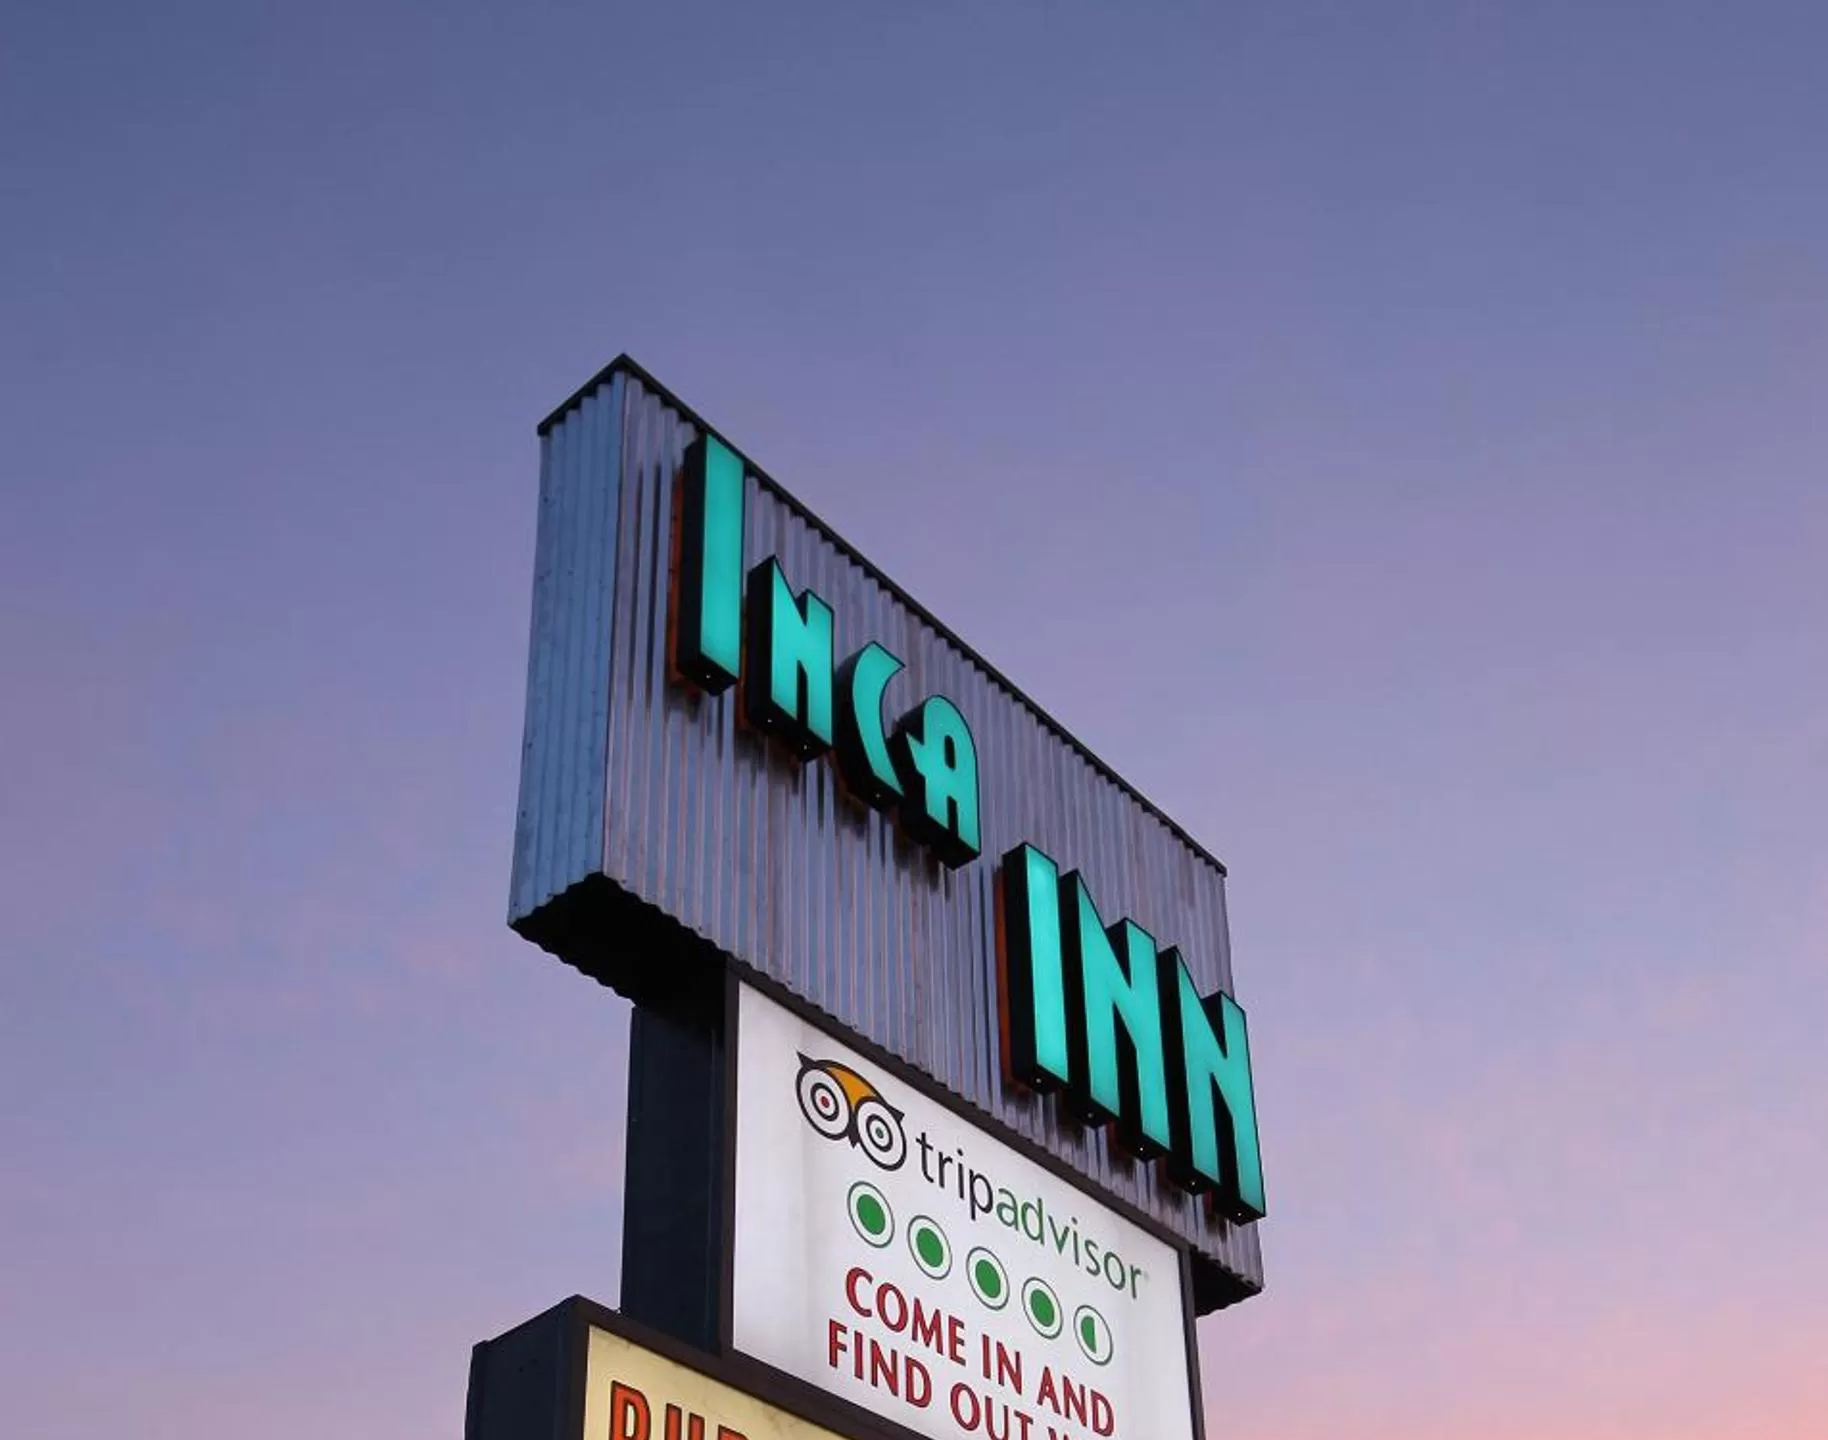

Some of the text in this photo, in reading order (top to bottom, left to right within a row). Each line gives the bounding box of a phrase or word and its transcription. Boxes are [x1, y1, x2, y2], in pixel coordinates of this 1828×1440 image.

[690, 434, 980, 864] INCA
[1012, 843, 1267, 1222] INN
[916, 1132, 1141, 1299] tripadvisor
[828, 1319, 933, 1408] FIND
[845, 1266, 1115, 1438] COME IN AND
